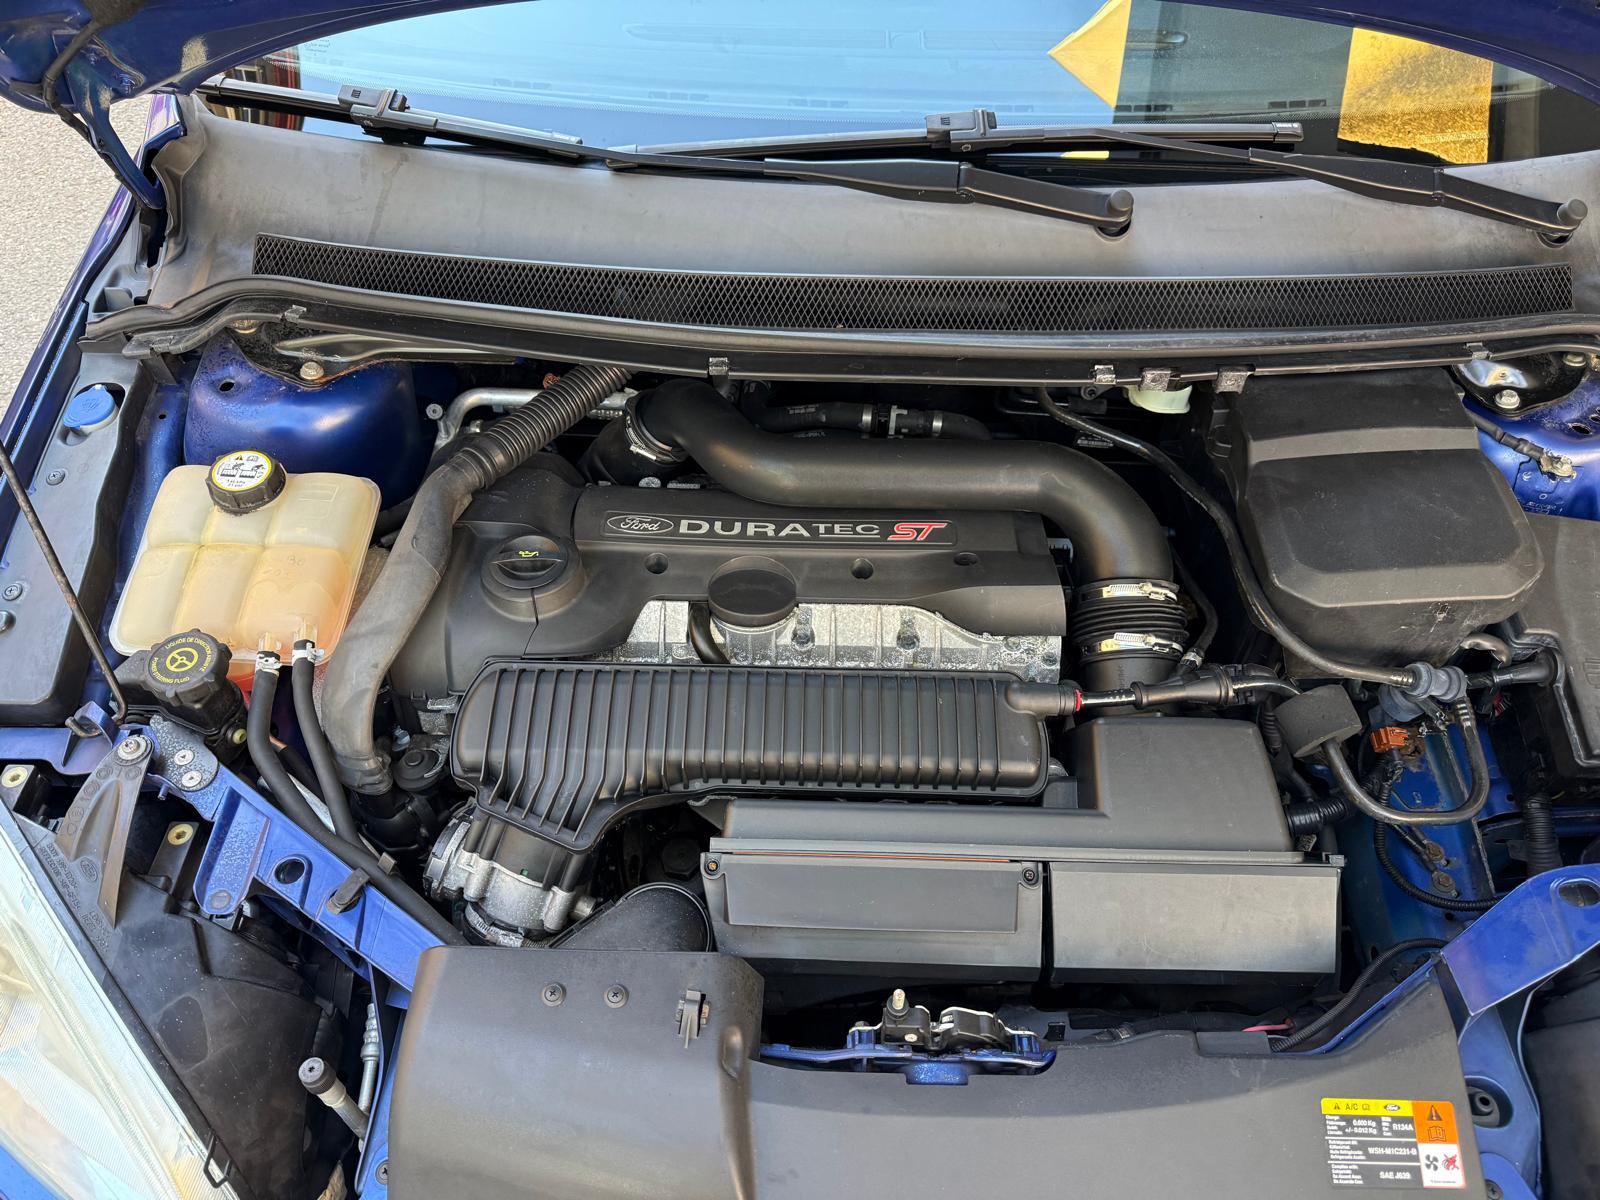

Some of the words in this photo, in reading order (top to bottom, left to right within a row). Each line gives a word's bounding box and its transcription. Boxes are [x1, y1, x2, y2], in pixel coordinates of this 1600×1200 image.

[620, 516, 662, 532] Ford
[678, 518, 881, 538] DURATEC
[887, 522, 948, 541] ST
[174, 676, 190, 684] FLUID
[1345, 1103, 1359, 1111] A/C
[1367, 1120, 1376, 1128] Kg
[1392, 1123, 1414, 1131] R134A
